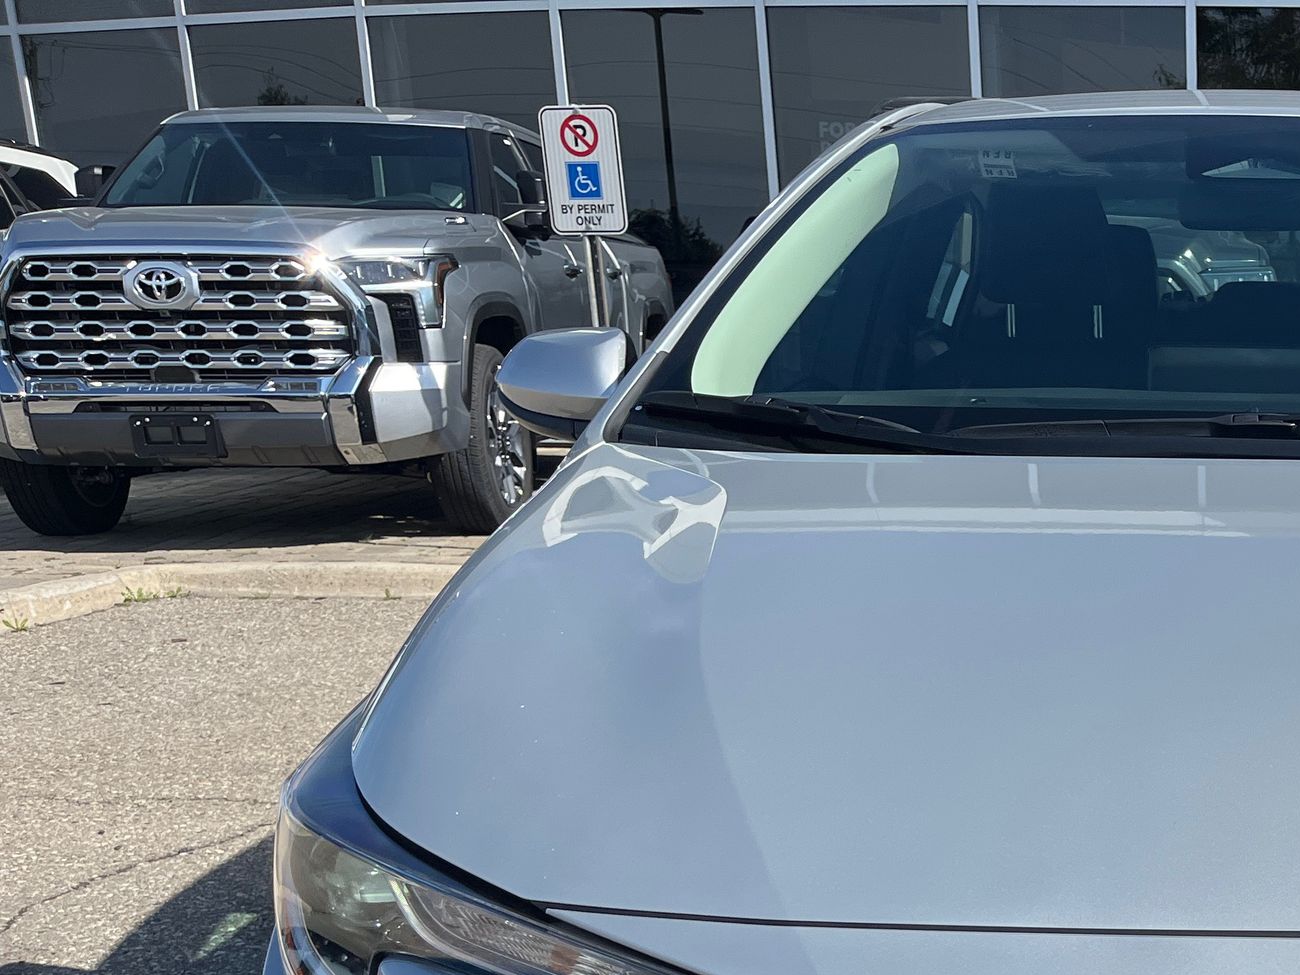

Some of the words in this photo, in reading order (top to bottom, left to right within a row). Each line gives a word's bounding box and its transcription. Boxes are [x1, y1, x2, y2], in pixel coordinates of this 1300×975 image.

[561, 204, 574, 214] BY
[577, 204, 614, 214] PERMIT
[576, 216, 602, 226] ONLY
